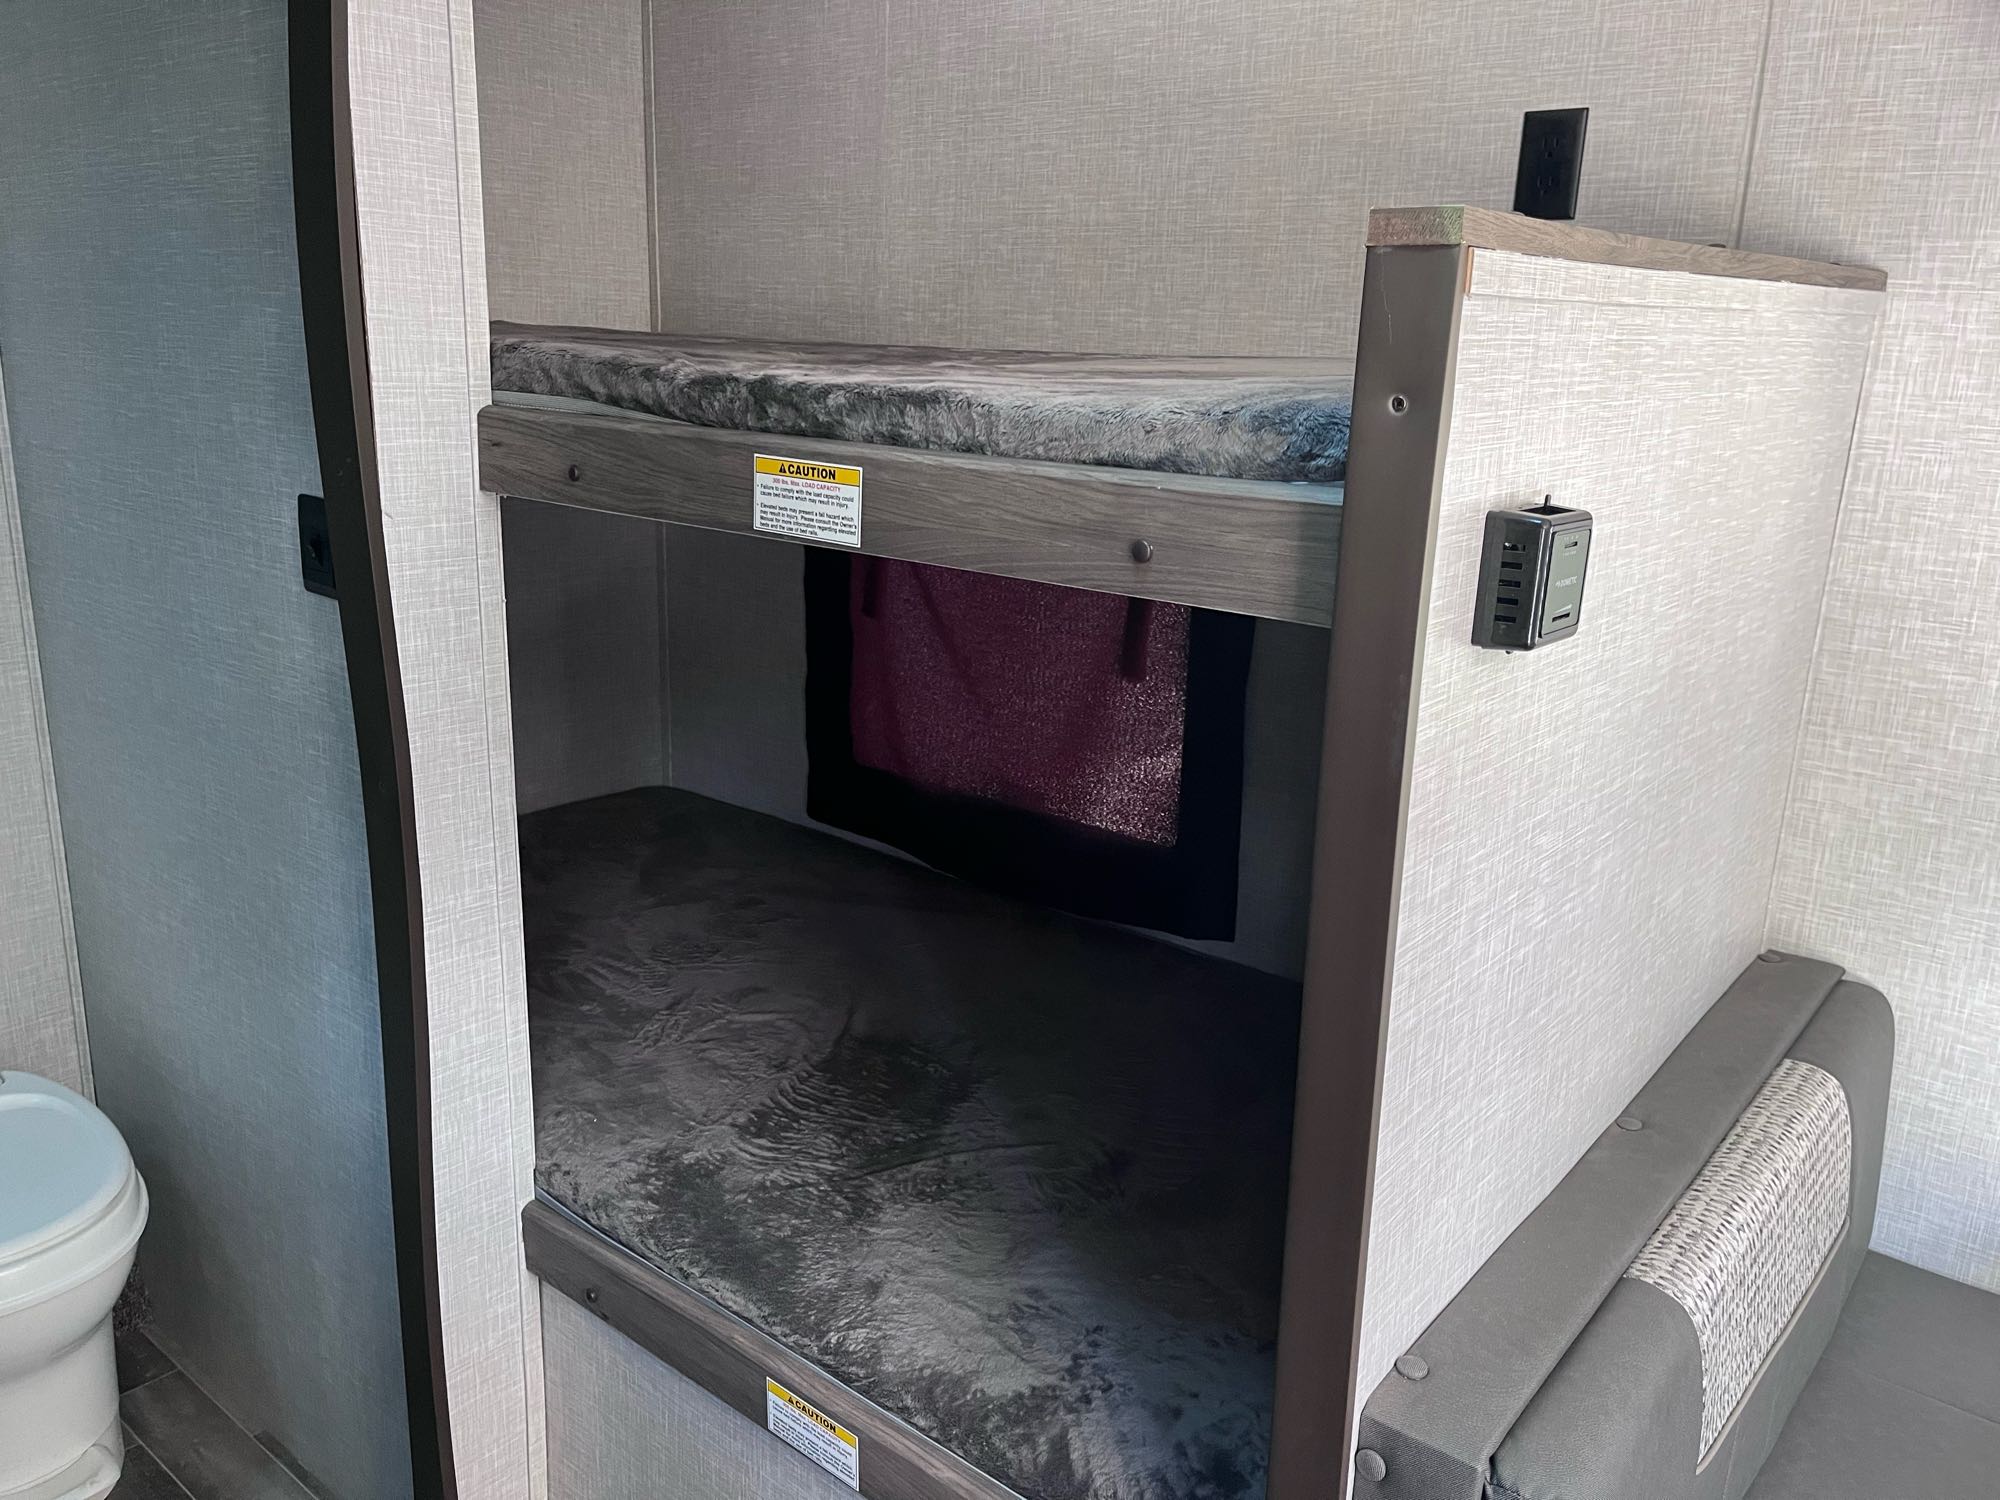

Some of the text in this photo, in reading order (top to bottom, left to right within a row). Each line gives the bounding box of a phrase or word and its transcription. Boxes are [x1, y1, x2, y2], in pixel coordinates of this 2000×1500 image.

[787, 463, 835, 480] CAUTION
[816, 484, 840, 492] CAPACITY
[795, 1401, 836, 1433] CAUTION
